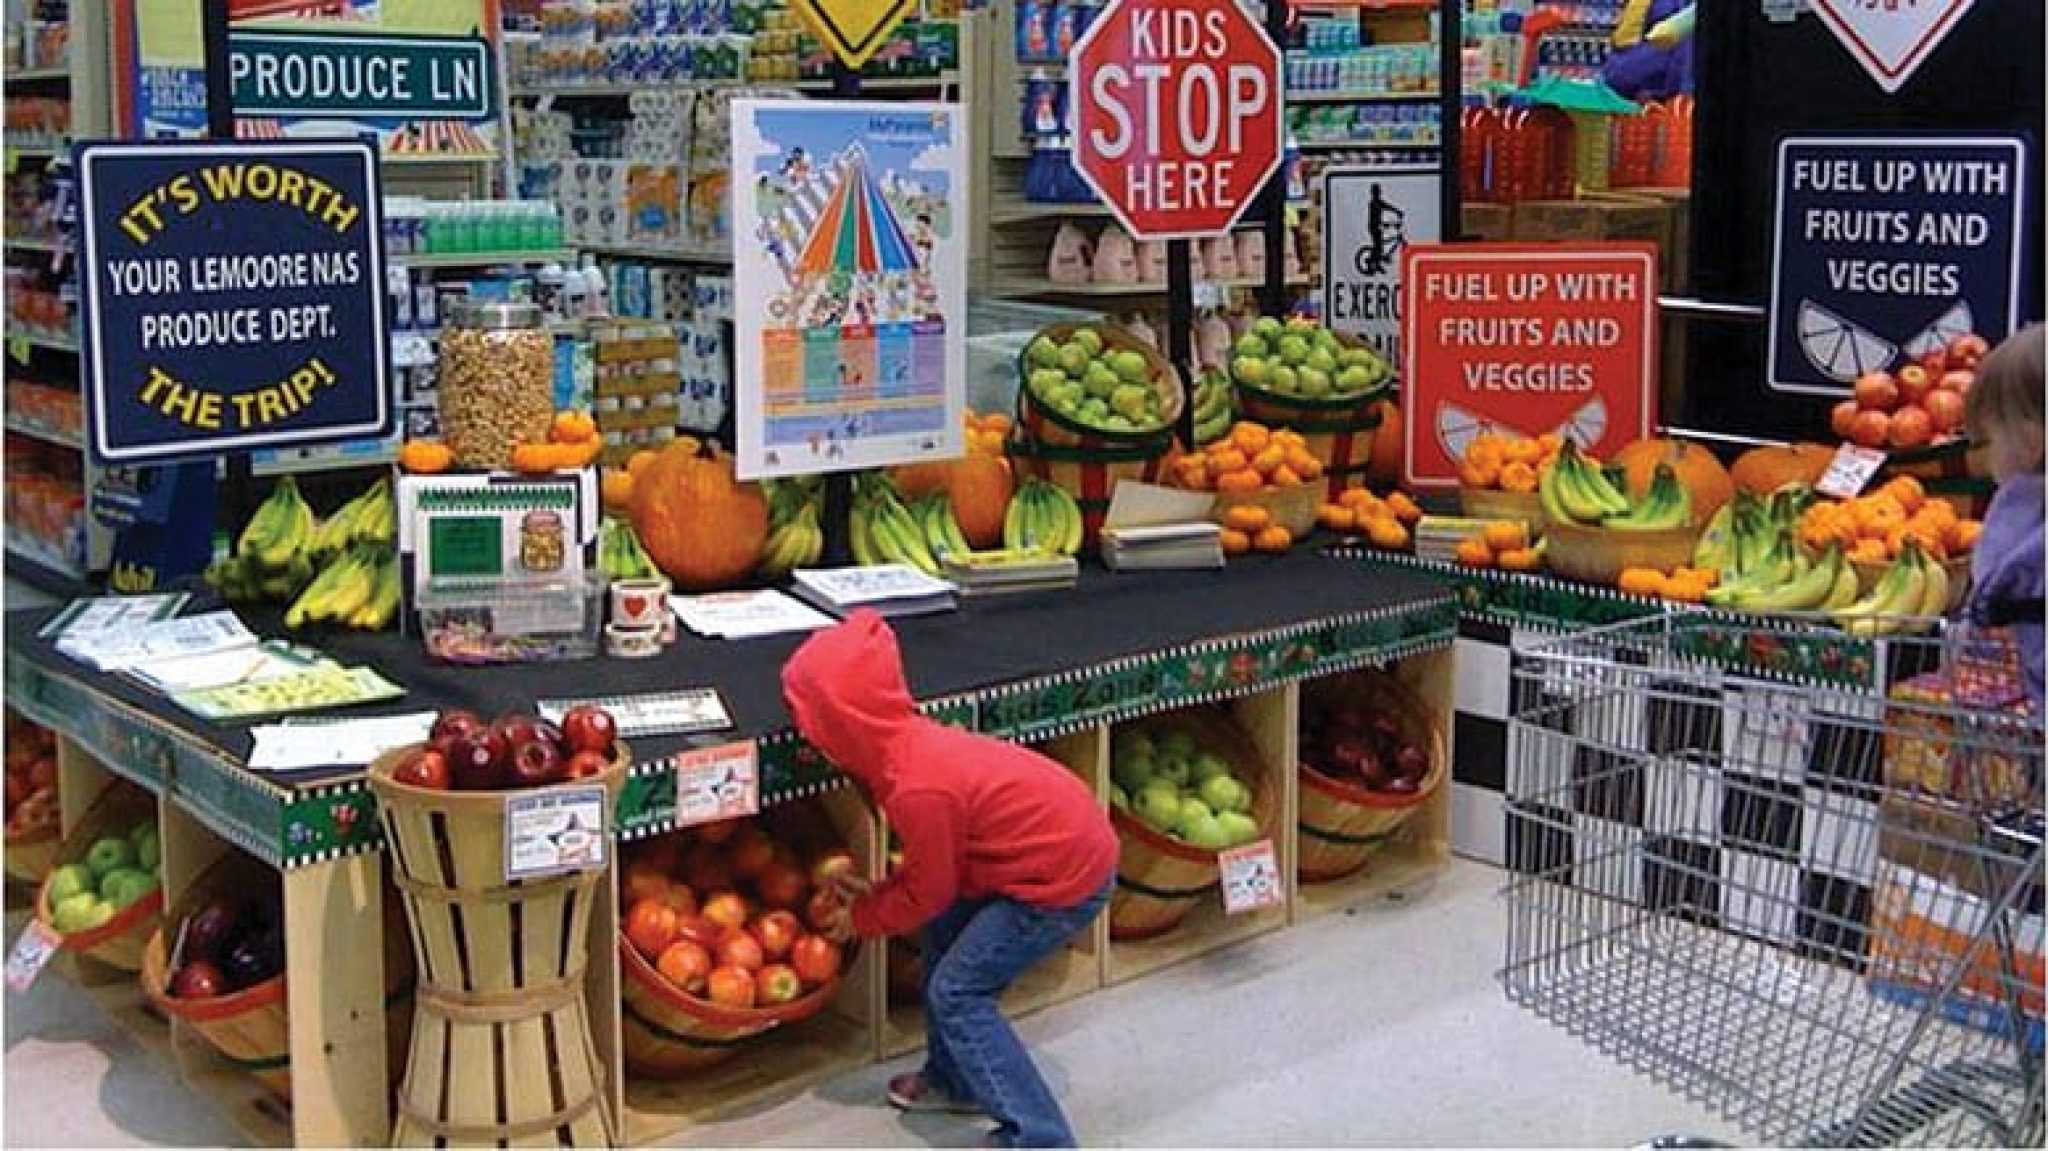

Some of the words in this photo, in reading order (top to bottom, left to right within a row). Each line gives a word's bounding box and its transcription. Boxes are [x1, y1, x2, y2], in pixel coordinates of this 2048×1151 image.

[1132, 7, 1227, 59] KIDS
[231, 53, 412, 99] PRODUCE
[431, 59, 476, 101] LN
[1090, 63, 1266, 158] STOP
[1126, 160, 1235, 211] HERE
[1793, 160, 1865, 192] FUEL
[1875, 161, 1916, 192] UP
[1923, 162, 2007, 195] WITH
[120, 174, 199, 244] IT'S
[200, 165, 359, 233] WORTH
[1804, 210, 1909, 243] FRUITS
[1916, 213, 1988, 246] AND
[107, 260, 180, 296] YOUR
[190, 254, 307, 291] LEMOORE
[313, 251, 359, 286] NAS
[1425, 272, 1498, 302] FUEL
[1506, 272, 1549, 302] UP
[1555, 272, 1636, 302] WITH
[1828, 259, 1959, 296] VEGGIES
[141, 308, 262, 349] PRODUCE
[270, 305, 337, 342] DEPT.
[1440, 317, 1544, 347] FRUITS
[1551, 317, 1620, 347] AND
[139, 367, 223, 429] THE
[231, 359, 337, 429] TRIP!
[1464, 362, 1594, 392] VEGGIES
